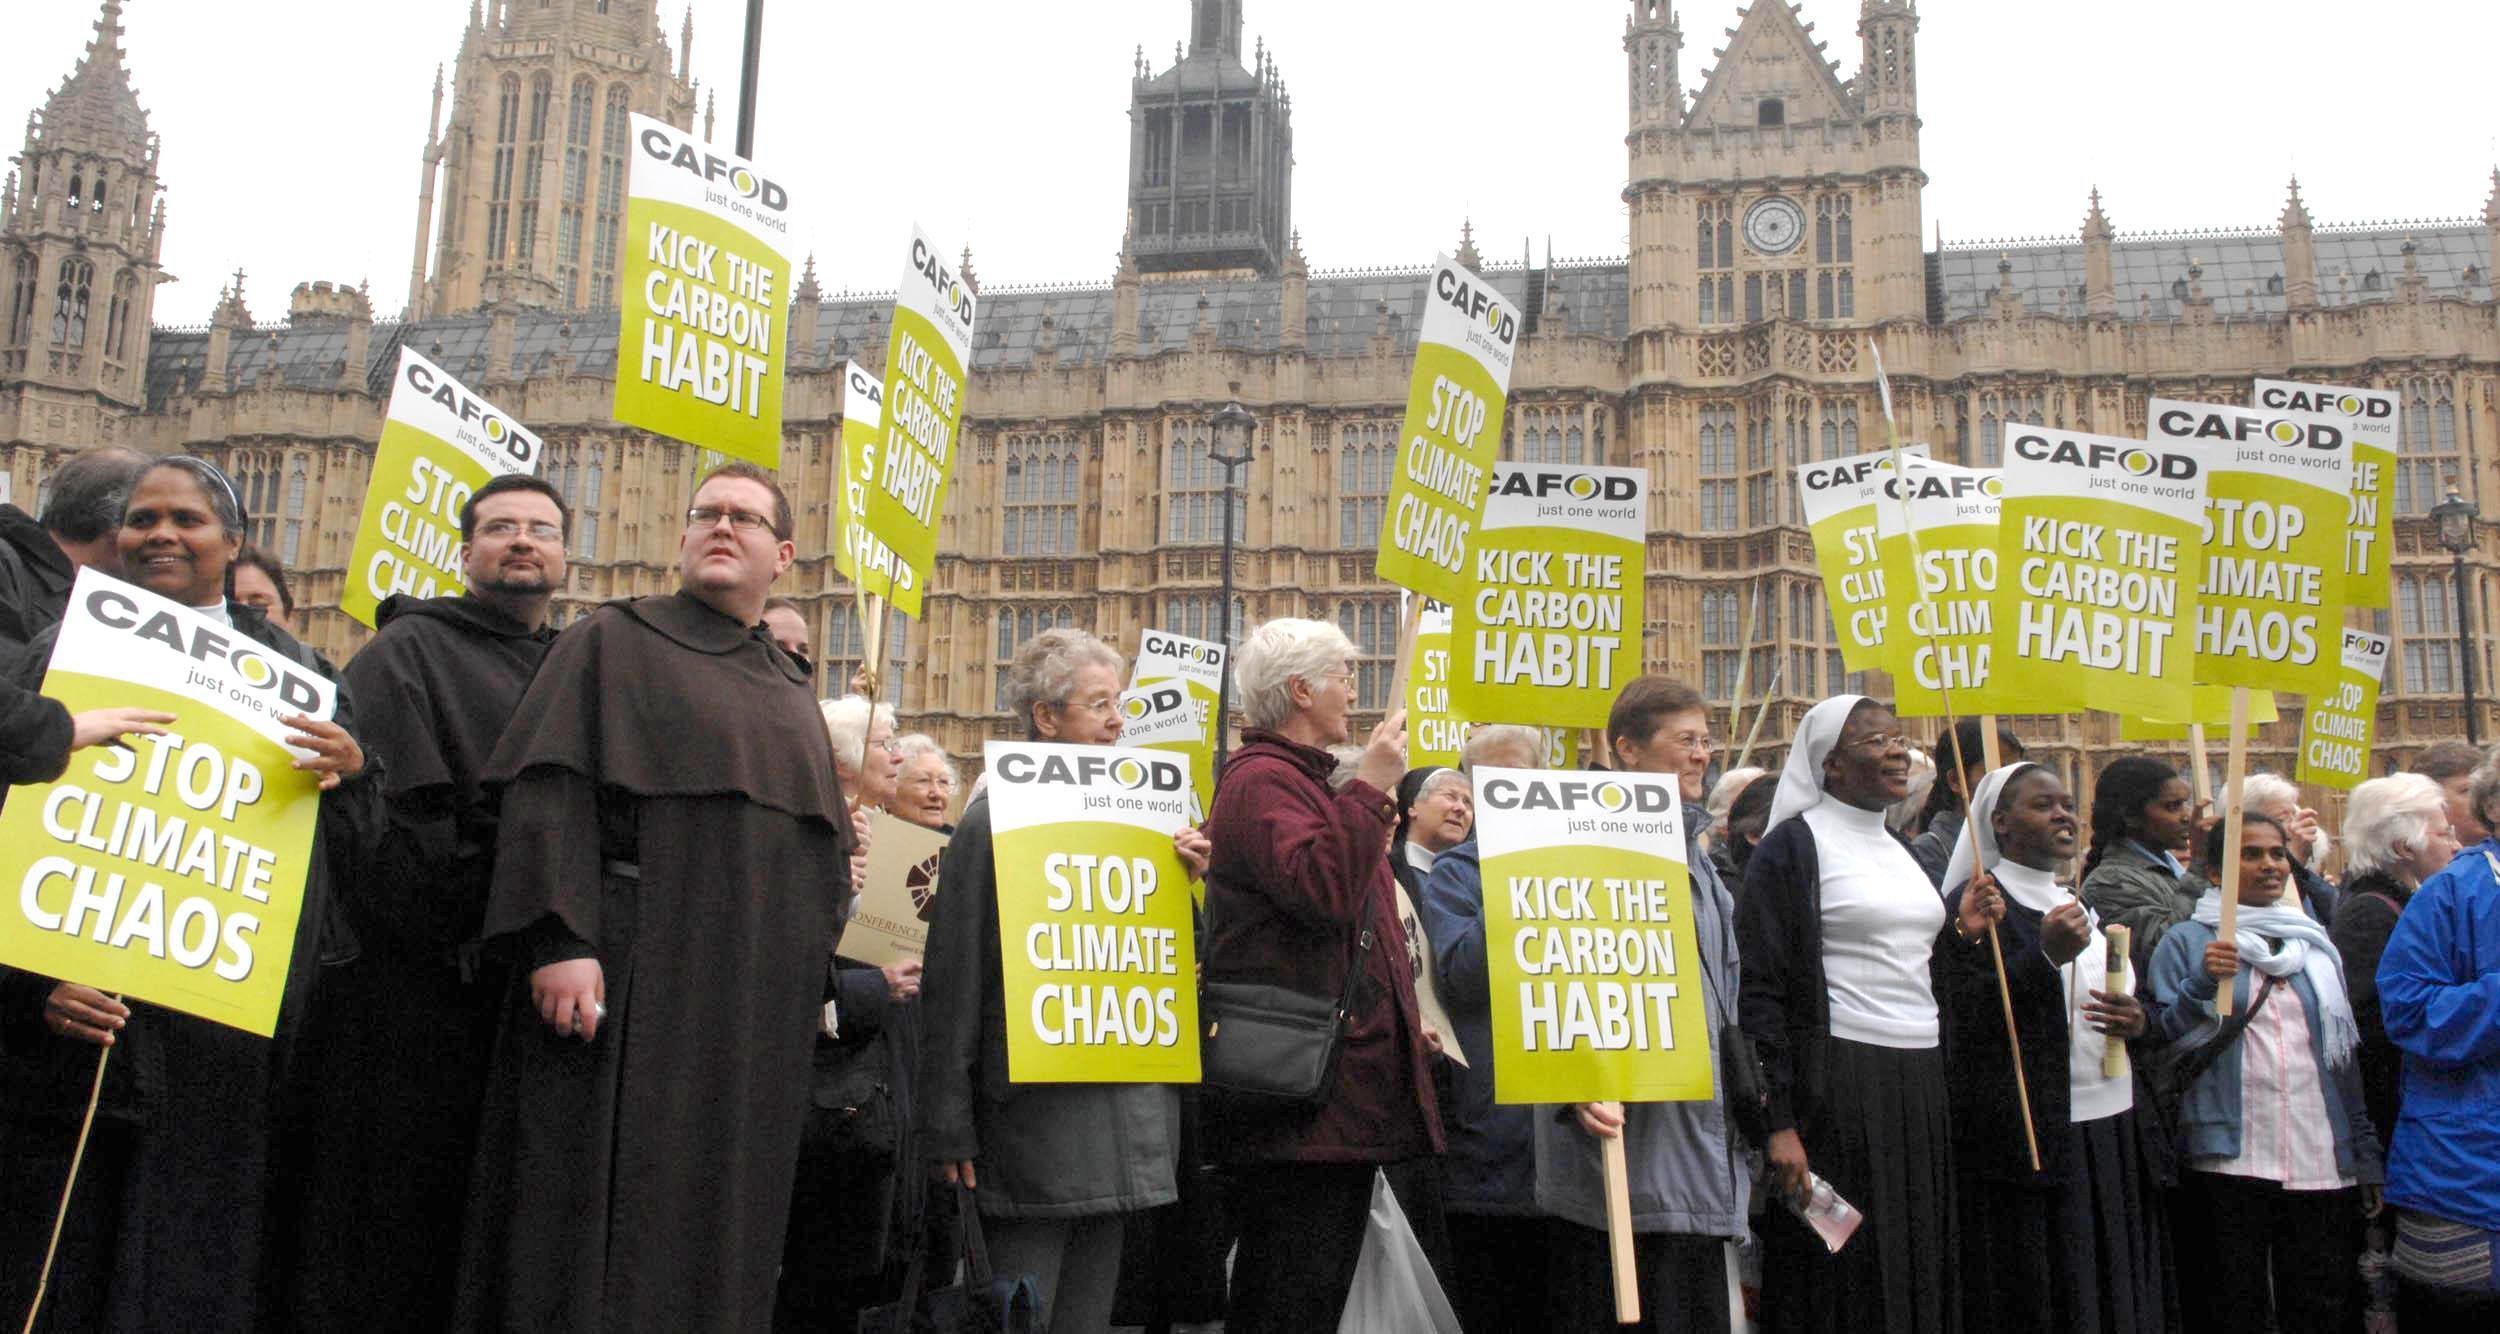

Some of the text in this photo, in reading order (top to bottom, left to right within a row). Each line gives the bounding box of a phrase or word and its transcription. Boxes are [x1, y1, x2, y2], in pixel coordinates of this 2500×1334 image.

[641, 129, 788, 212] CAFOD
[705, 187, 787, 233] just one world
[648, 221, 773, 308] KICK THE
[913, 238, 972, 327] CAFOD
[645, 270, 771, 356] CARBON
[1437, 269, 1514, 344] CAFOD
[1466, 324, 1482, 346] just
[641, 318, 768, 419] HABIT
[899, 331, 933, 395] KICK
[933, 364, 957, 420] THE
[407, 364, 532, 462] CAFOD
[893, 379, 950, 467] CARBON
[1426, 375, 1485, 450] STOP
[2262, 388, 2391, 417] CAFOD
[456, 425, 478, 446] just
[478, 443, 497, 461] one
[2159, 410, 2343, 450] CAFOD
[2362, 423, 2391, 433] world
[881, 427, 942, 528] HABIT
[1407, 435, 1482, 511] CLIMATE
[1806, 457, 1894, 491] CAF
[2015, 435, 2198, 480] CAFOD
[2237, 448, 2341, 470] just one world
[2350, 462, 2379, 492] HE
[406, 456, 472, 530] STO
[1860, 486, 1875, 499] jus
[1884, 475, 2002, 500] CAFO
[1957, 503, 2001, 516] just on
[2089, 474, 2195, 500] just one world
[1394, 492, 1470, 574] CHAOS
[1537, 503, 1636, 519] just one world
[380, 501, 464, 584] CLIMA
[1843, 526, 1880, 566] ST
[2023, 515, 2178, 573] KICK THE
[1477, 549, 1622, 589] KICK THE
[1923, 548, 1998, 594] STO
[2020, 557, 2176, 618] CARBON
[2199, 556, 2322, 606] IMATE
[1475, 588, 1622, 633] CARBON
[1908, 600, 1993, 637] CLIM
[86, 590, 320, 713] CAFOD
[1146, 637, 1220, 666] CAFOD
[2018, 601, 2173, 678] HABIT
[2196, 605, 2318, 666] HAOS
[2345, 634, 2385, 655] FOD
[1178, 662, 1189, 673] just
[1424, 650, 1450, 682] ST
[1474, 630, 1620, 690] HABIT
[1914, 644, 1992, 690] CHA
[186, 667, 263, 711] just one
[1129, 723, 1151, 737] one
[1155, 713, 1188, 730] world
[2313, 711, 2366, 742] CLIMATE
[997, 753, 1182, 791] CAFOD
[2309, 739, 2362, 775] CHAOS
[1084, 793, 1183, 814] just one world
[1483, 779, 1671, 814] CAFOD
[43, 785, 276, 904] CLIMATE
[1567, 818, 1673, 834] just one world
[1044, 852, 1157, 915] STOP
[1509, 876, 1670, 923] KICK THE
[20, 856, 260, 982] CHAOS
[854, 912, 920, 939] ONFERENCE
[1025, 922, 1177, 975] CLIMATE
[1514, 927, 1678, 977] CARBON
[1031, 983, 1179, 1047] CHAOS
[1520, 981, 1678, 1052] HABIT
